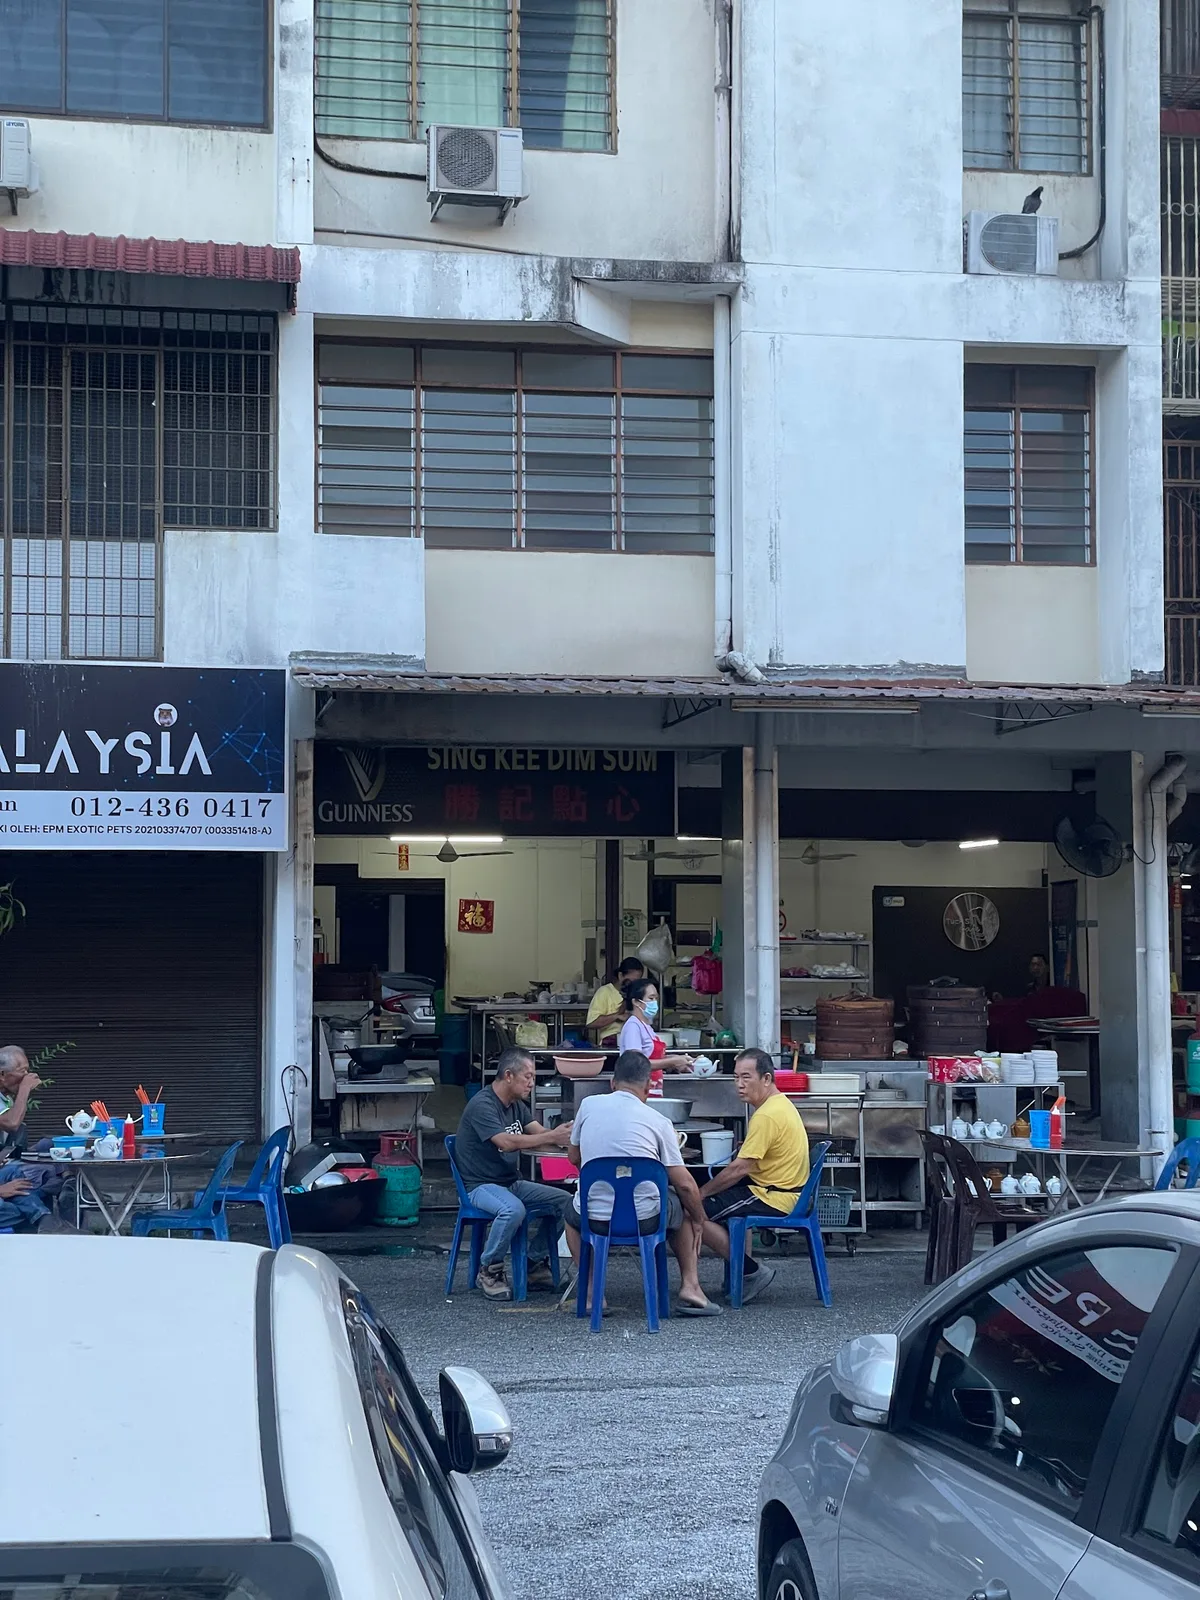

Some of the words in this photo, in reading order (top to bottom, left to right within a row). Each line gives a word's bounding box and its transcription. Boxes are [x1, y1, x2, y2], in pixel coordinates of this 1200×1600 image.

[428, 747, 487, 770] SING
[494, 748, 541, 770] KEE
[547, 749, 596, 771] DIM
[602, 750, 658, 772] SUM
[71, 796, 189, 818] 012-436
[203, 798, 273, 818] 0417
[9, 825, 40, 834] OLEH:
[43, 825, 64, 834] EPM
[67, 825, 104, 834] EXOTIC
[107, 826, 133, 834] PETS
[134, 825, 203, 834] 202103374707
[204, 826, 272, 835] (003351418-A)
